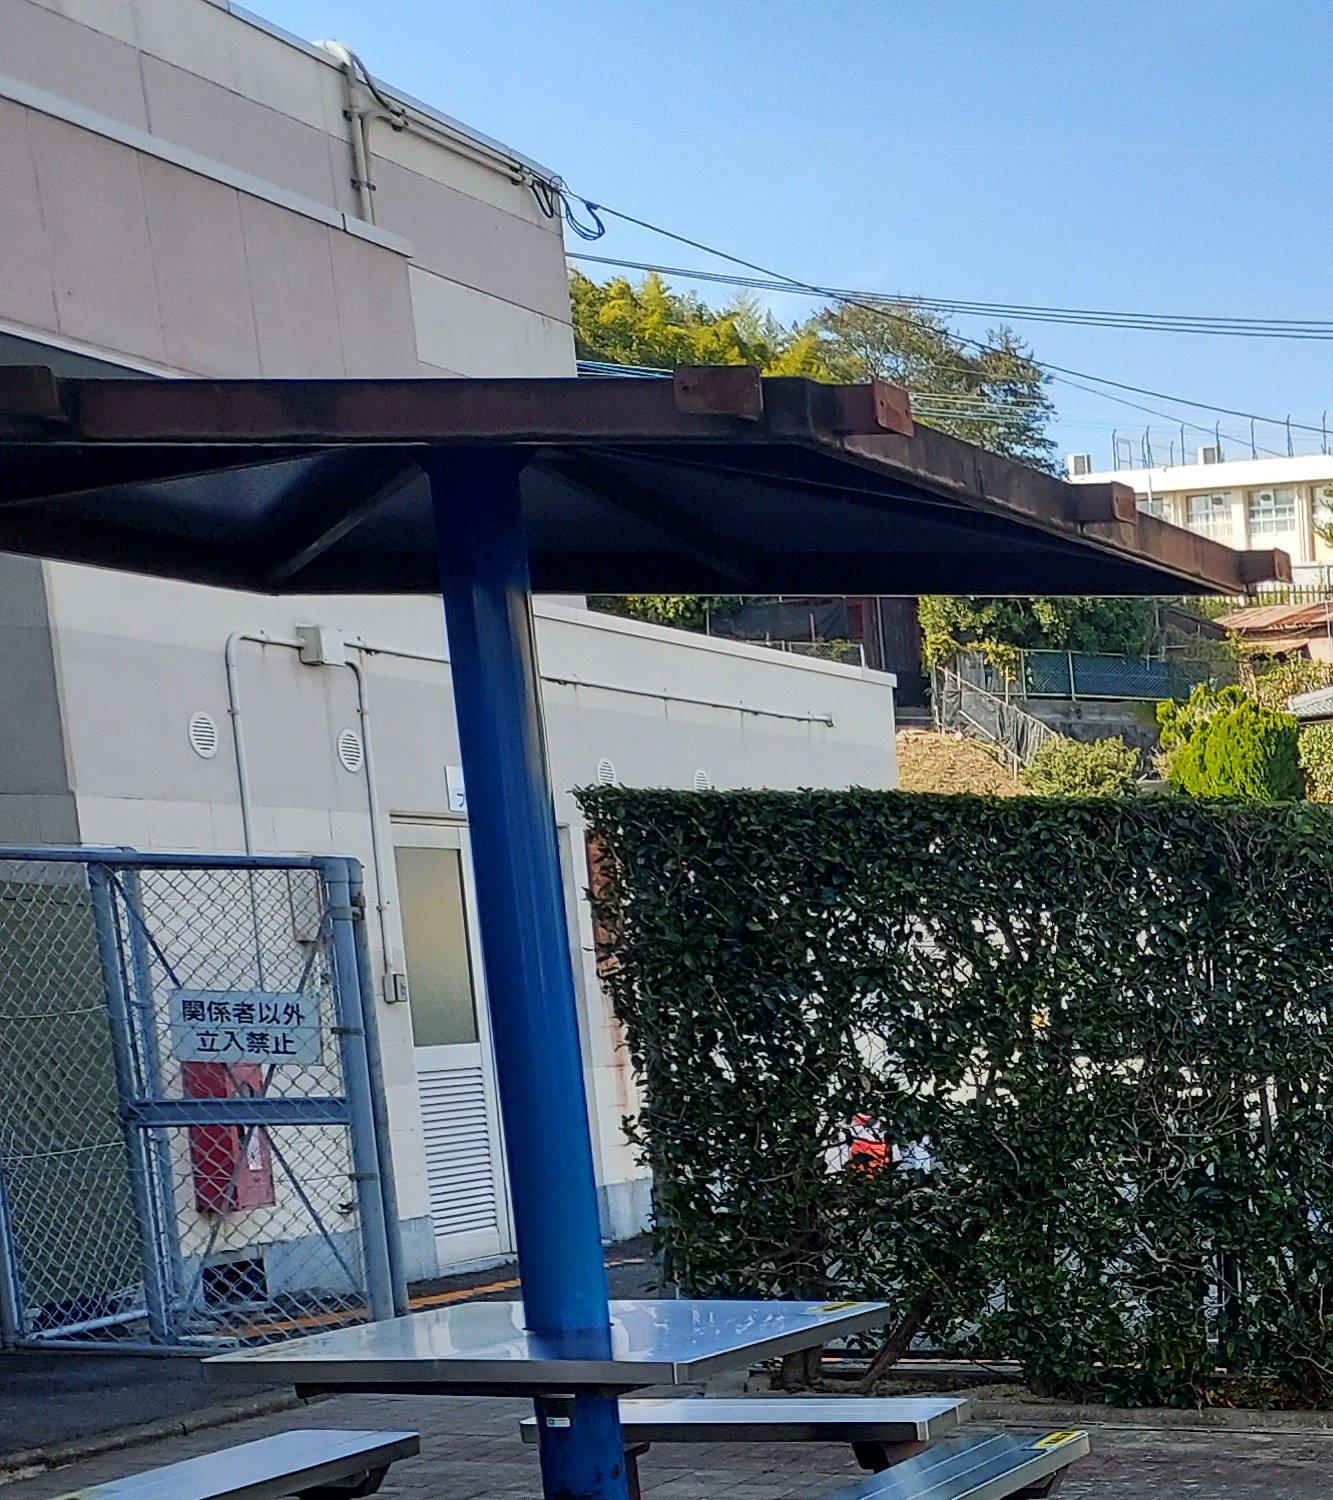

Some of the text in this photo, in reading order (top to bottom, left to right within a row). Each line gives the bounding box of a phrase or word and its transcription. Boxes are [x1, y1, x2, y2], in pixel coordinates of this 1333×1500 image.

[181, 1000, 305, 1026] 関係者以外
[196, 1030, 298, 1055] 立入禁止
